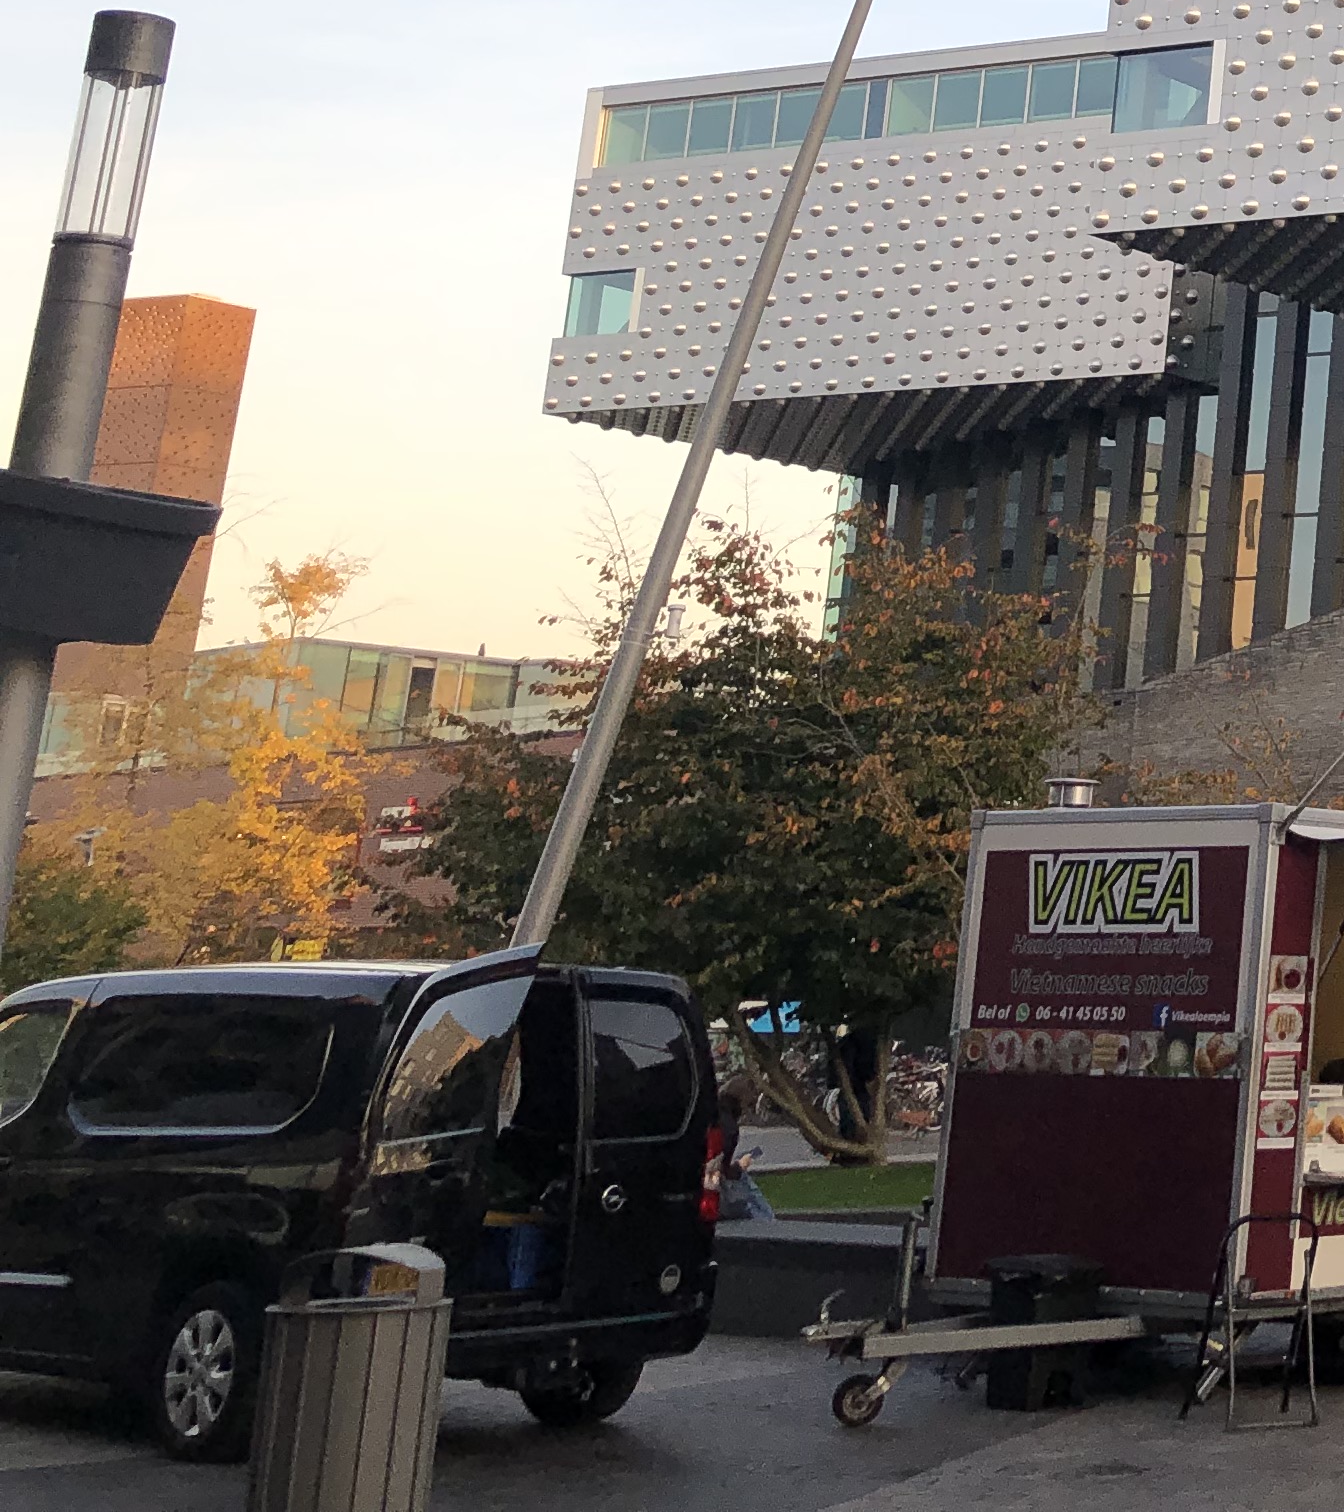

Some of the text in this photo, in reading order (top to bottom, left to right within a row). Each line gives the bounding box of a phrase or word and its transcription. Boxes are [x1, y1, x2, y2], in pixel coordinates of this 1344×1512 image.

[1032, 855, 1195, 927] VIKEA
[1010, 967, 1209, 996] Vietnamese snacks
[977, 1004, 997, 1020] Bel
[998, 1004, 1012, 1020] of
[1035, 1006, 1051, 1021] 06
[1059, 1006, 1075, 1021] 41
[1076, 1006, 1092, 1021] 45
[1093, 1006, 1109, 1021] 05
[1109, 1006, 1127, 1021] 50
